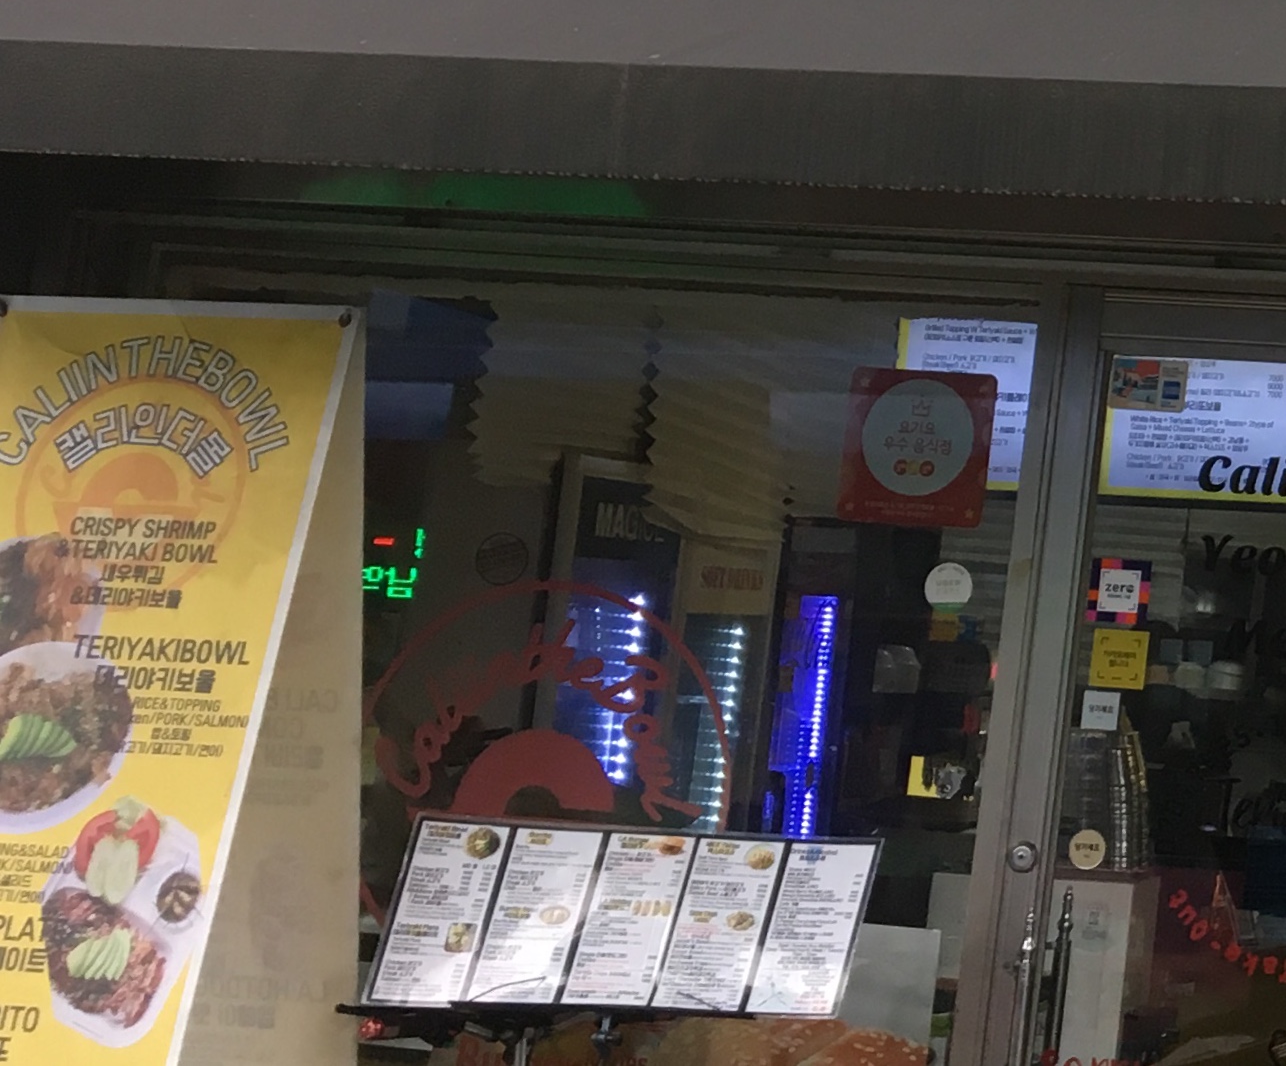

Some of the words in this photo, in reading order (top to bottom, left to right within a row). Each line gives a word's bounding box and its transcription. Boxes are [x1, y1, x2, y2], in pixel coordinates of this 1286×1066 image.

[897, 421, 936, 436] 요기요
[70, 516, 140, 538] CRISPY
[142, 518, 217, 541] SHRIMP
[161, 541, 218, 565] BOWL
[1104, 581, 1135, 594] zero
[73, 633, 251, 667] TERIYAKIBOWL
